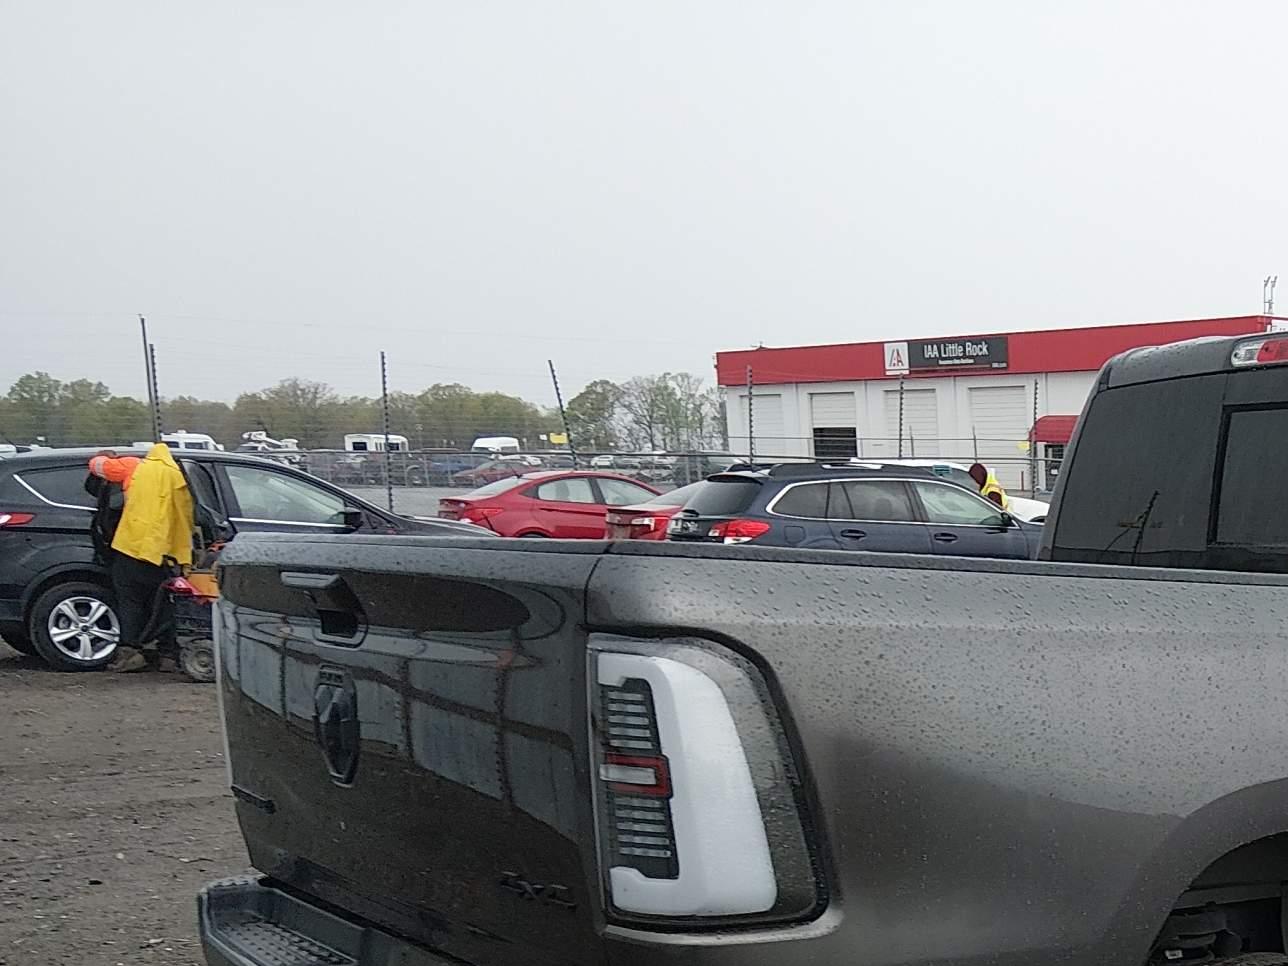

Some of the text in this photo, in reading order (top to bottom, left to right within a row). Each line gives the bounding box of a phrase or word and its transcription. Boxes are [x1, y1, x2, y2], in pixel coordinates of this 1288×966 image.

[924, 341, 989, 358] IAA Little Rock
